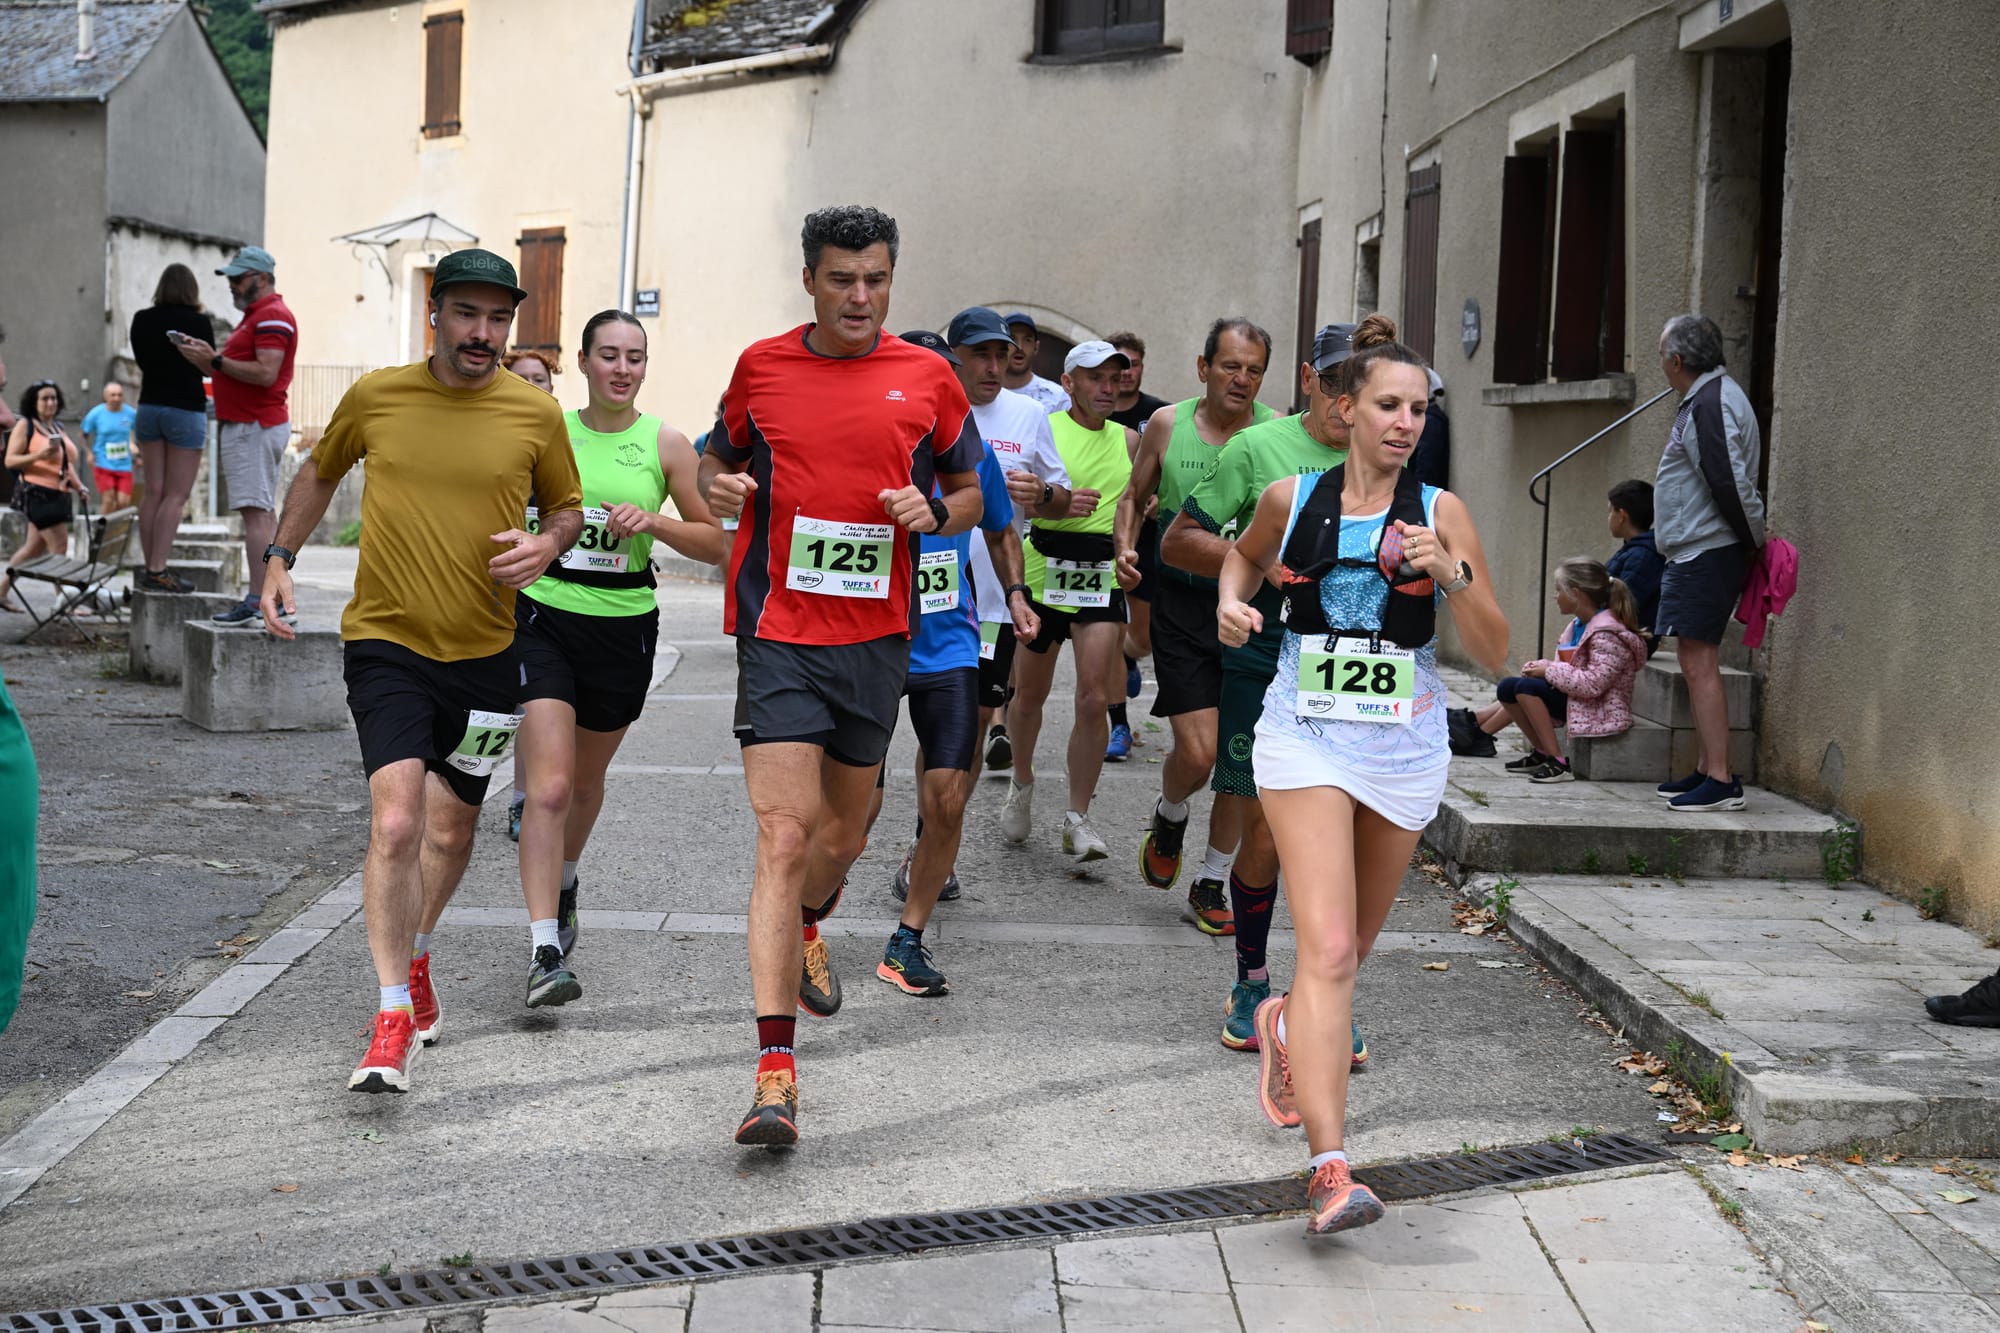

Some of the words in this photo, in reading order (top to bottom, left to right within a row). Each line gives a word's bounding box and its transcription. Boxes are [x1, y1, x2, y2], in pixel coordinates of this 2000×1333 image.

[844, 525, 874, 534] Challenge
[807, 540, 878, 573] 125
[797, 575, 819, 583] BFP
[842, 580, 871, 588] TUFF'S
[1056, 571, 1102, 592] 124
[1316, 658, 1396, 695] 128
[1308, 699, 1332, 707] BFP
[1356, 702, 1390, 712] TUFF'S
[476, 730, 515, 755] 12
